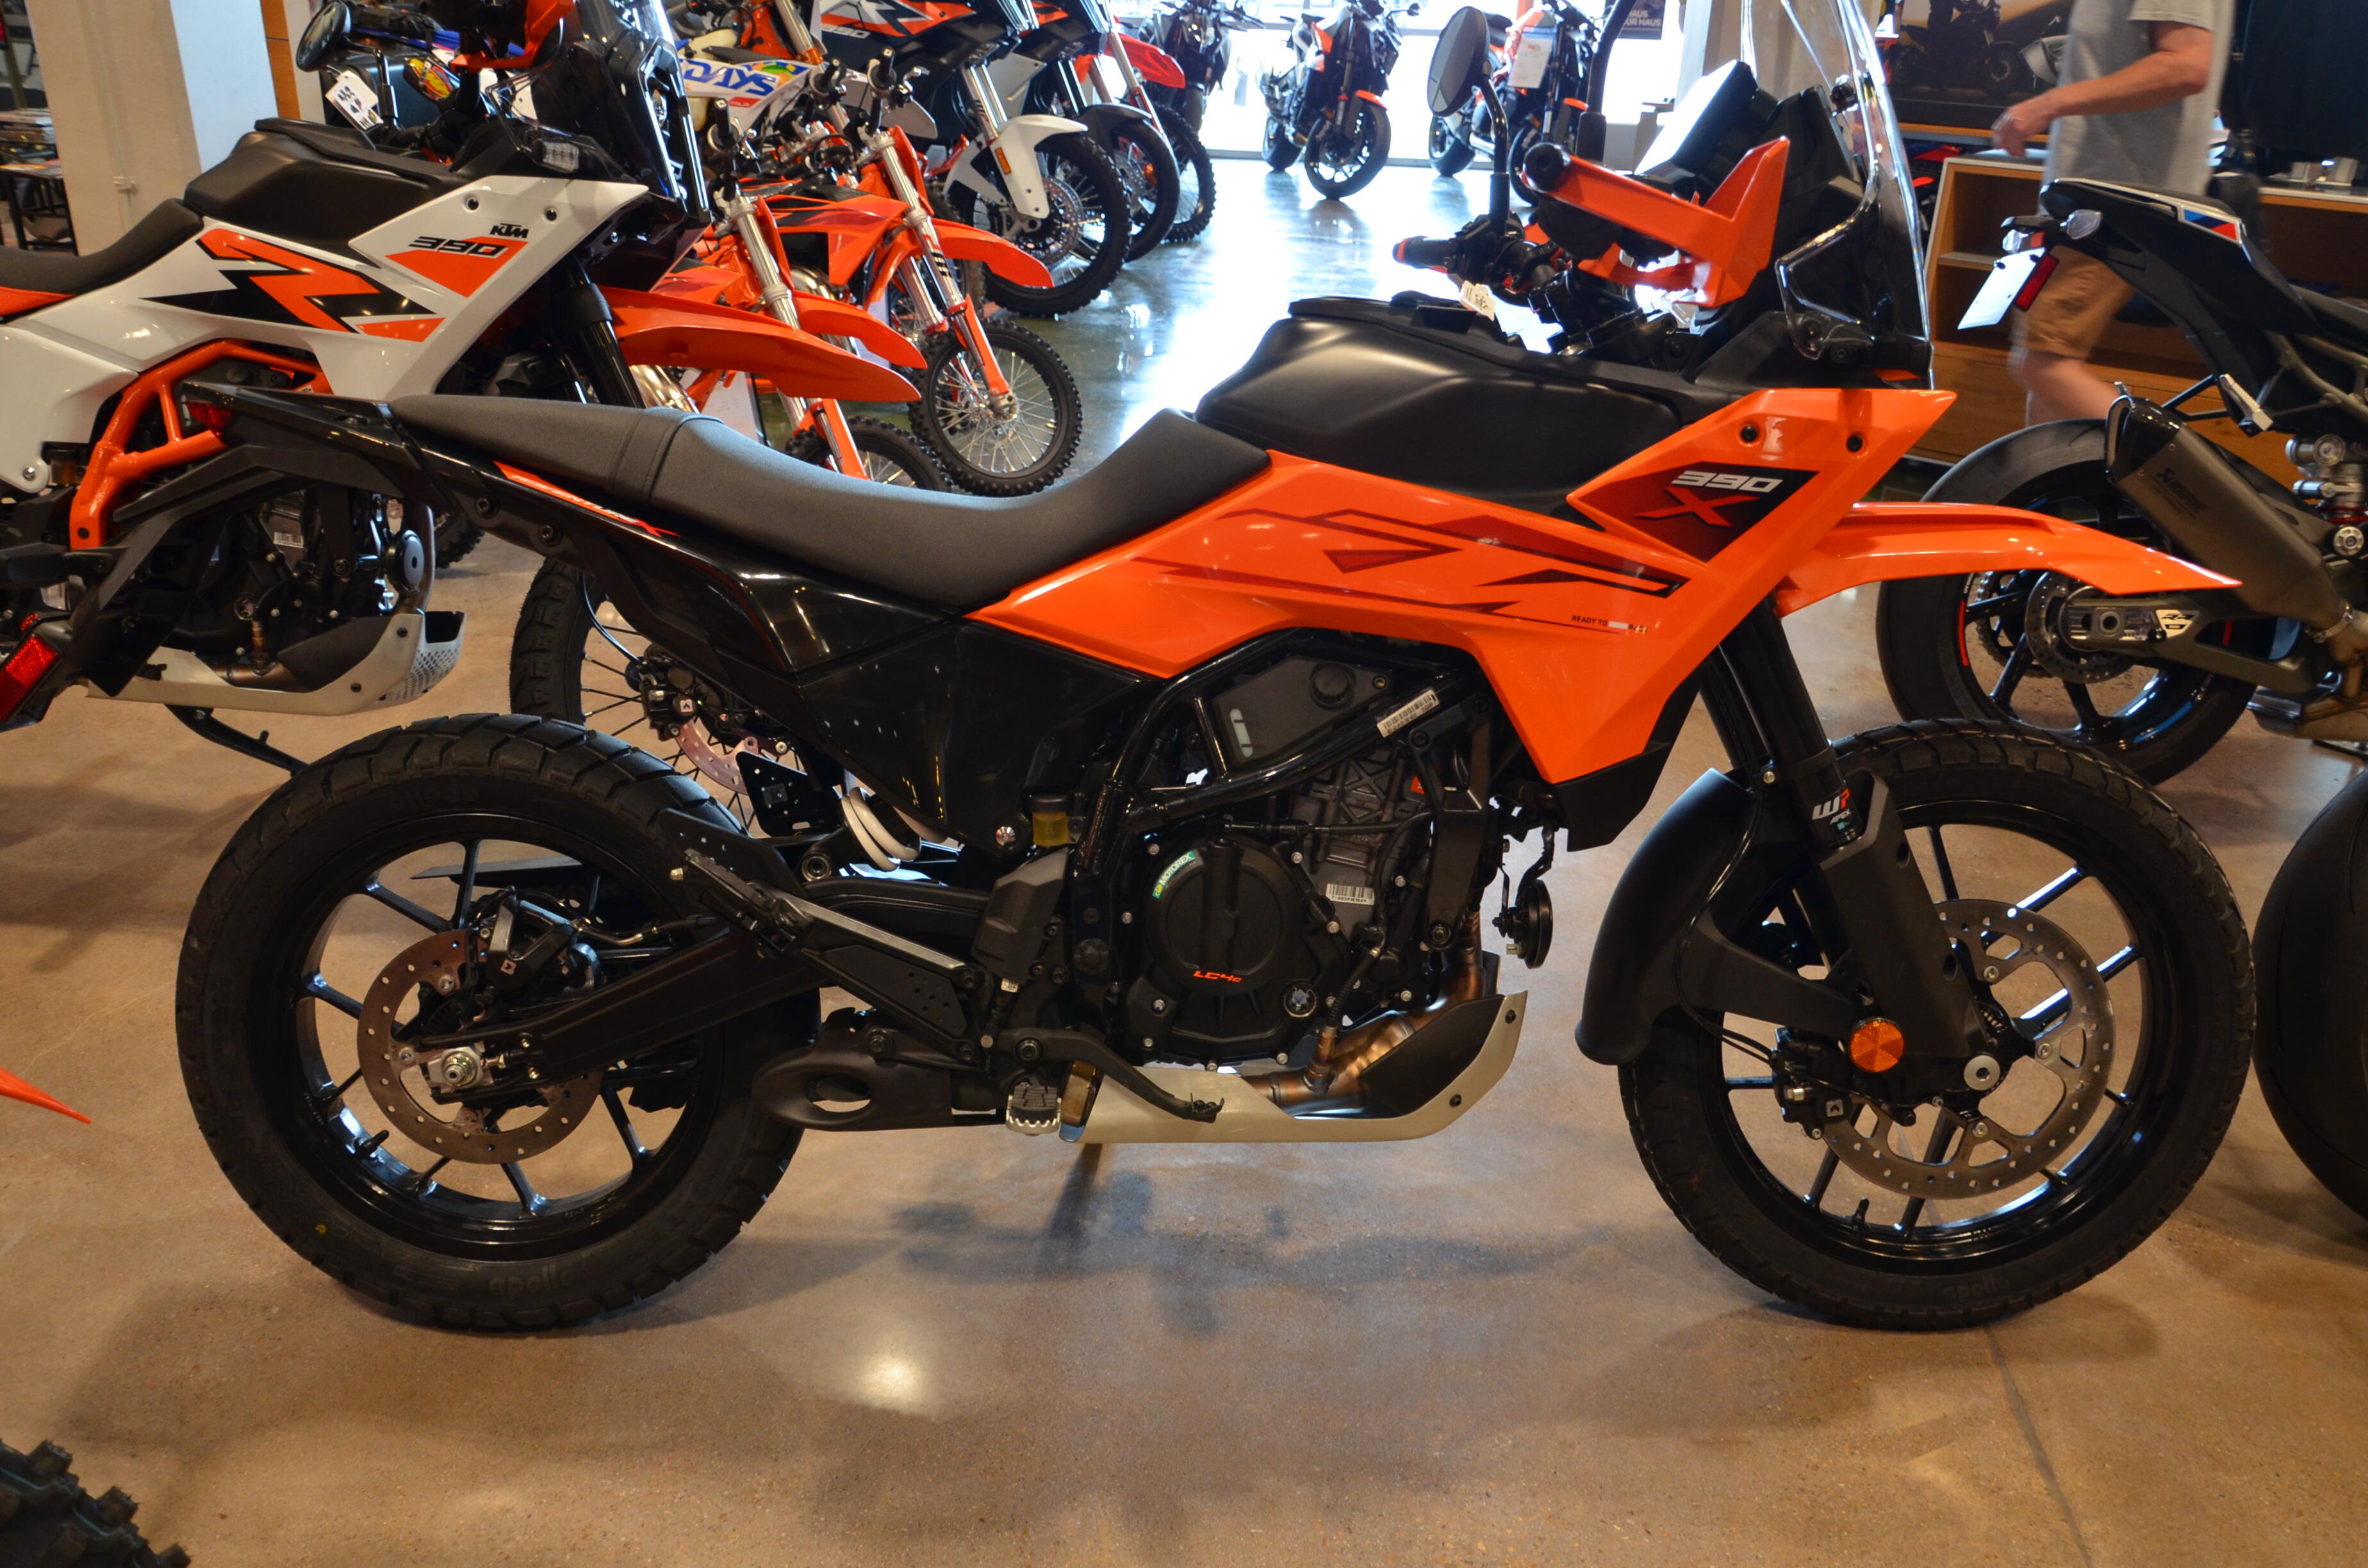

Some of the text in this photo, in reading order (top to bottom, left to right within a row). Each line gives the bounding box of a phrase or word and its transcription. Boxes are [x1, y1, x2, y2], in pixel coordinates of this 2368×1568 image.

[684, 59, 776, 96] DAYS
[489, 223, 529, 238] KTM
[409, 236, 507, 256] 390
[1671, 470, 1784, 493] 390
[1634, 486, 1761, 527] X
[1572, 615, 1596, 624] READY
[1812, 787, 1850, 820] WP
[1830, 808, 1851, 824] APEX
[1159, 853, 1195, 885] MOTOREX
